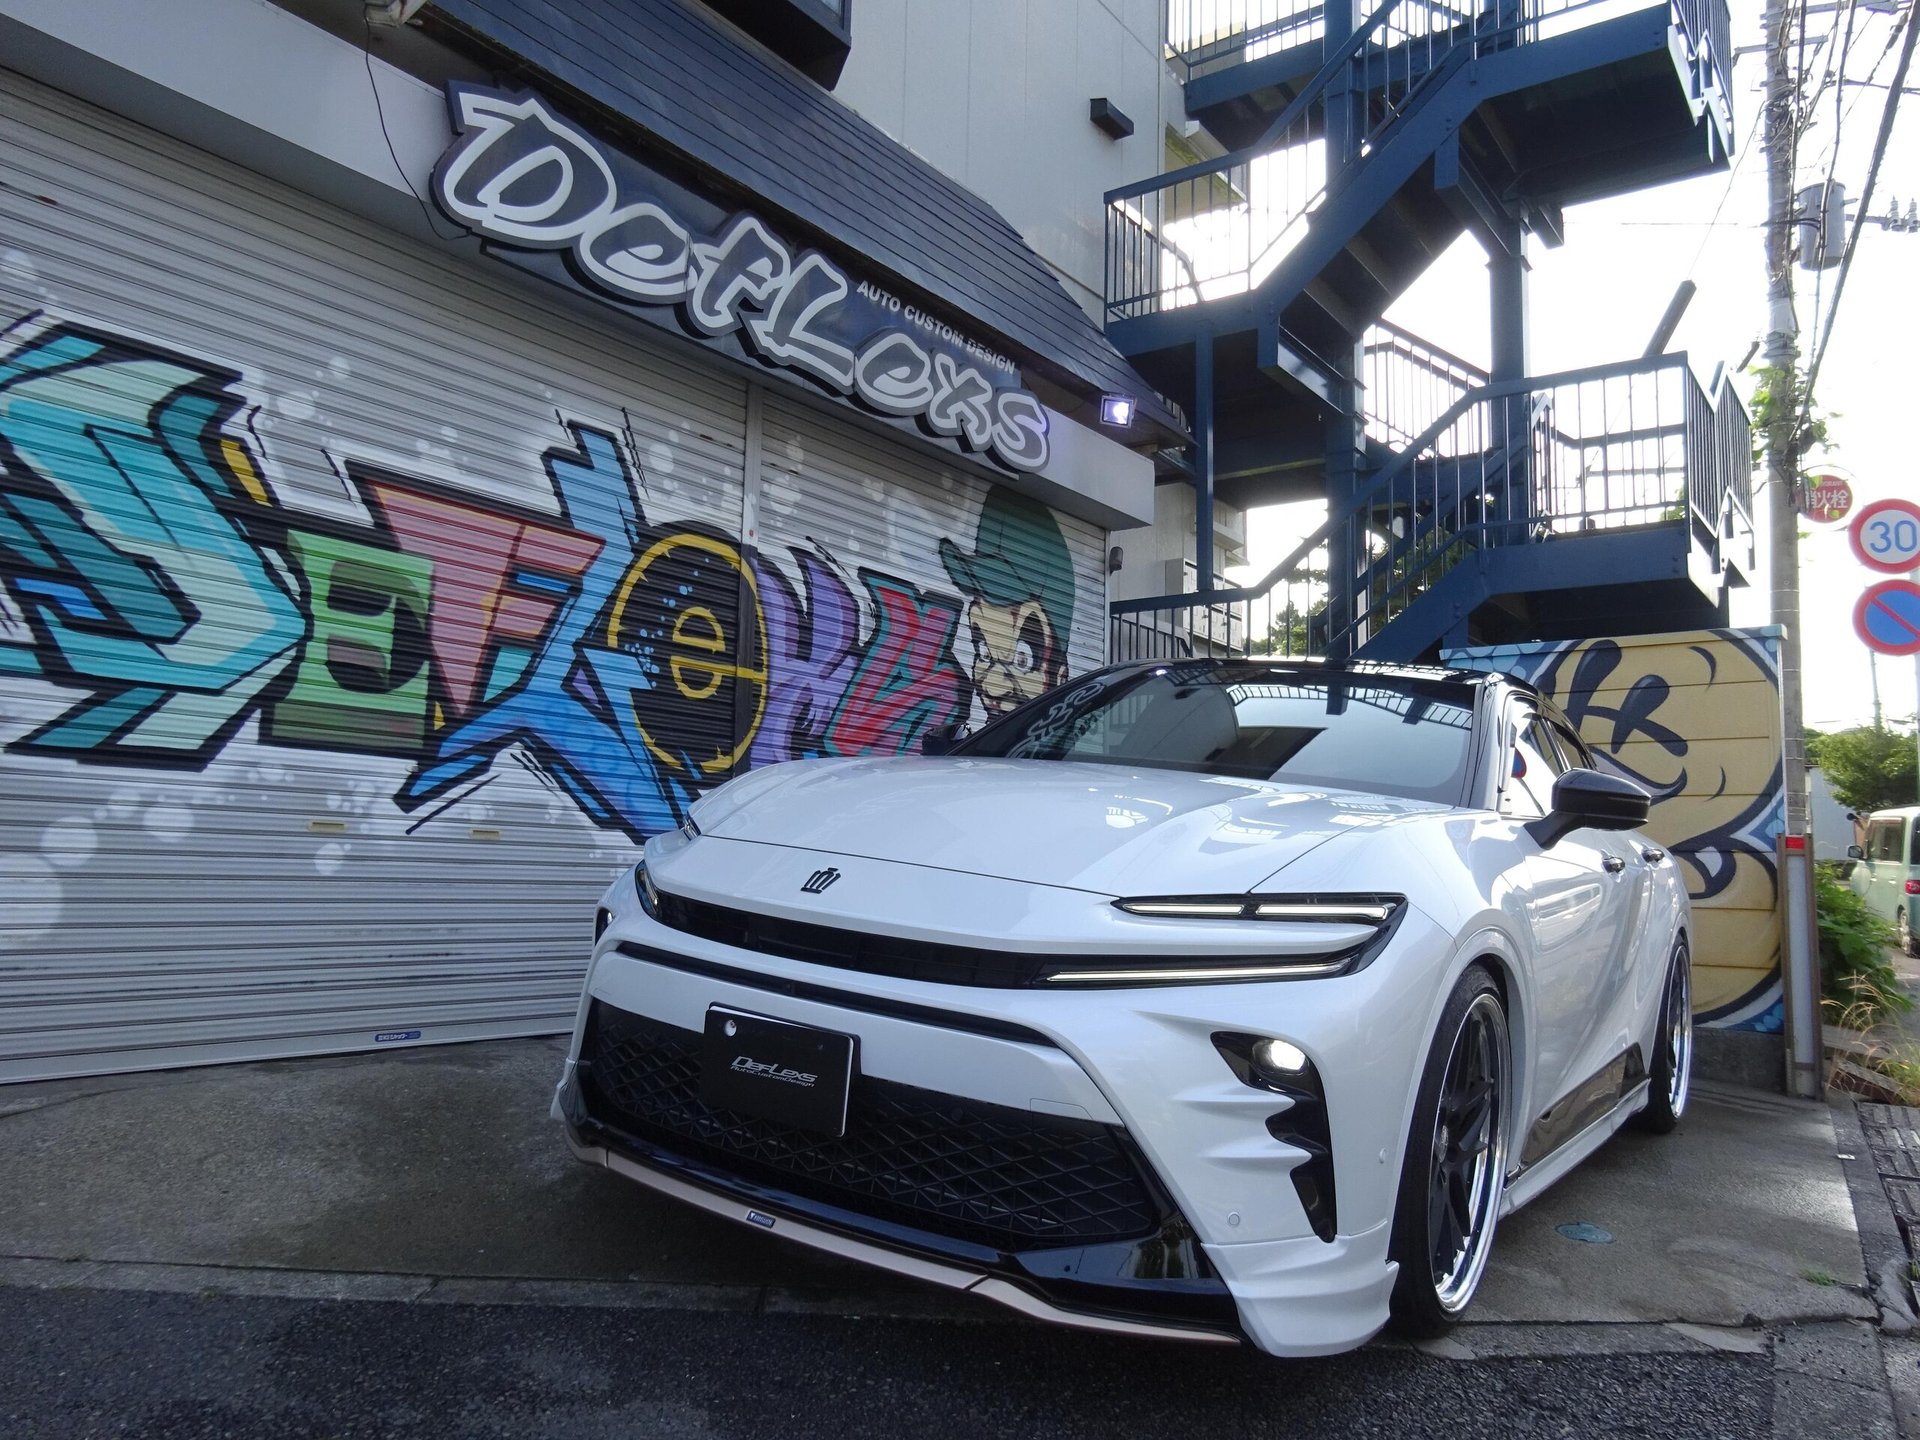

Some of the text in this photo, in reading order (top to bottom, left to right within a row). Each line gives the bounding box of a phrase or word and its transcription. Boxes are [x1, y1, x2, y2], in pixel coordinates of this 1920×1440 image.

[856, 280, 1016, 375] AUTO CUSTOM DESIGN
[1869, 520, 1918, 553] 30
